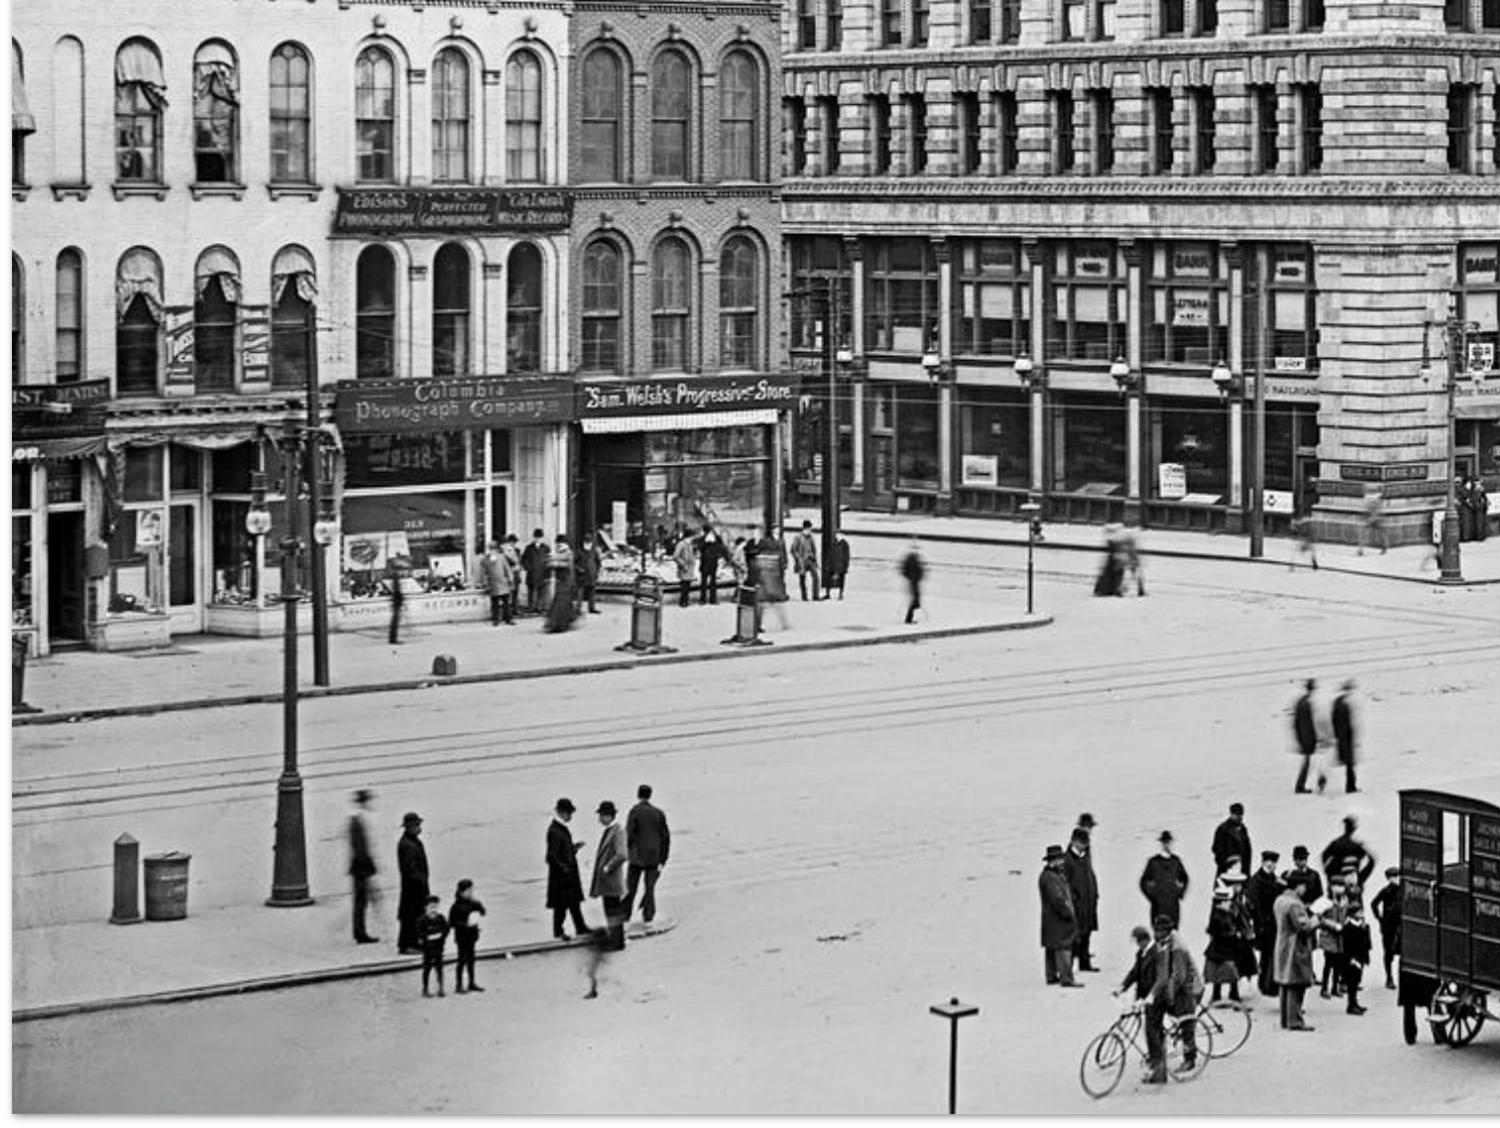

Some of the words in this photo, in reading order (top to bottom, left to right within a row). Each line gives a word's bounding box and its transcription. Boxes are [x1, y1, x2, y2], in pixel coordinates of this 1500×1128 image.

[415, 384, 505, 402] Columbia
[676, 380, 754, 409] Progressive
[754, 379, 793, 400] Store
[355, 400, 460, 423] Phonograph
